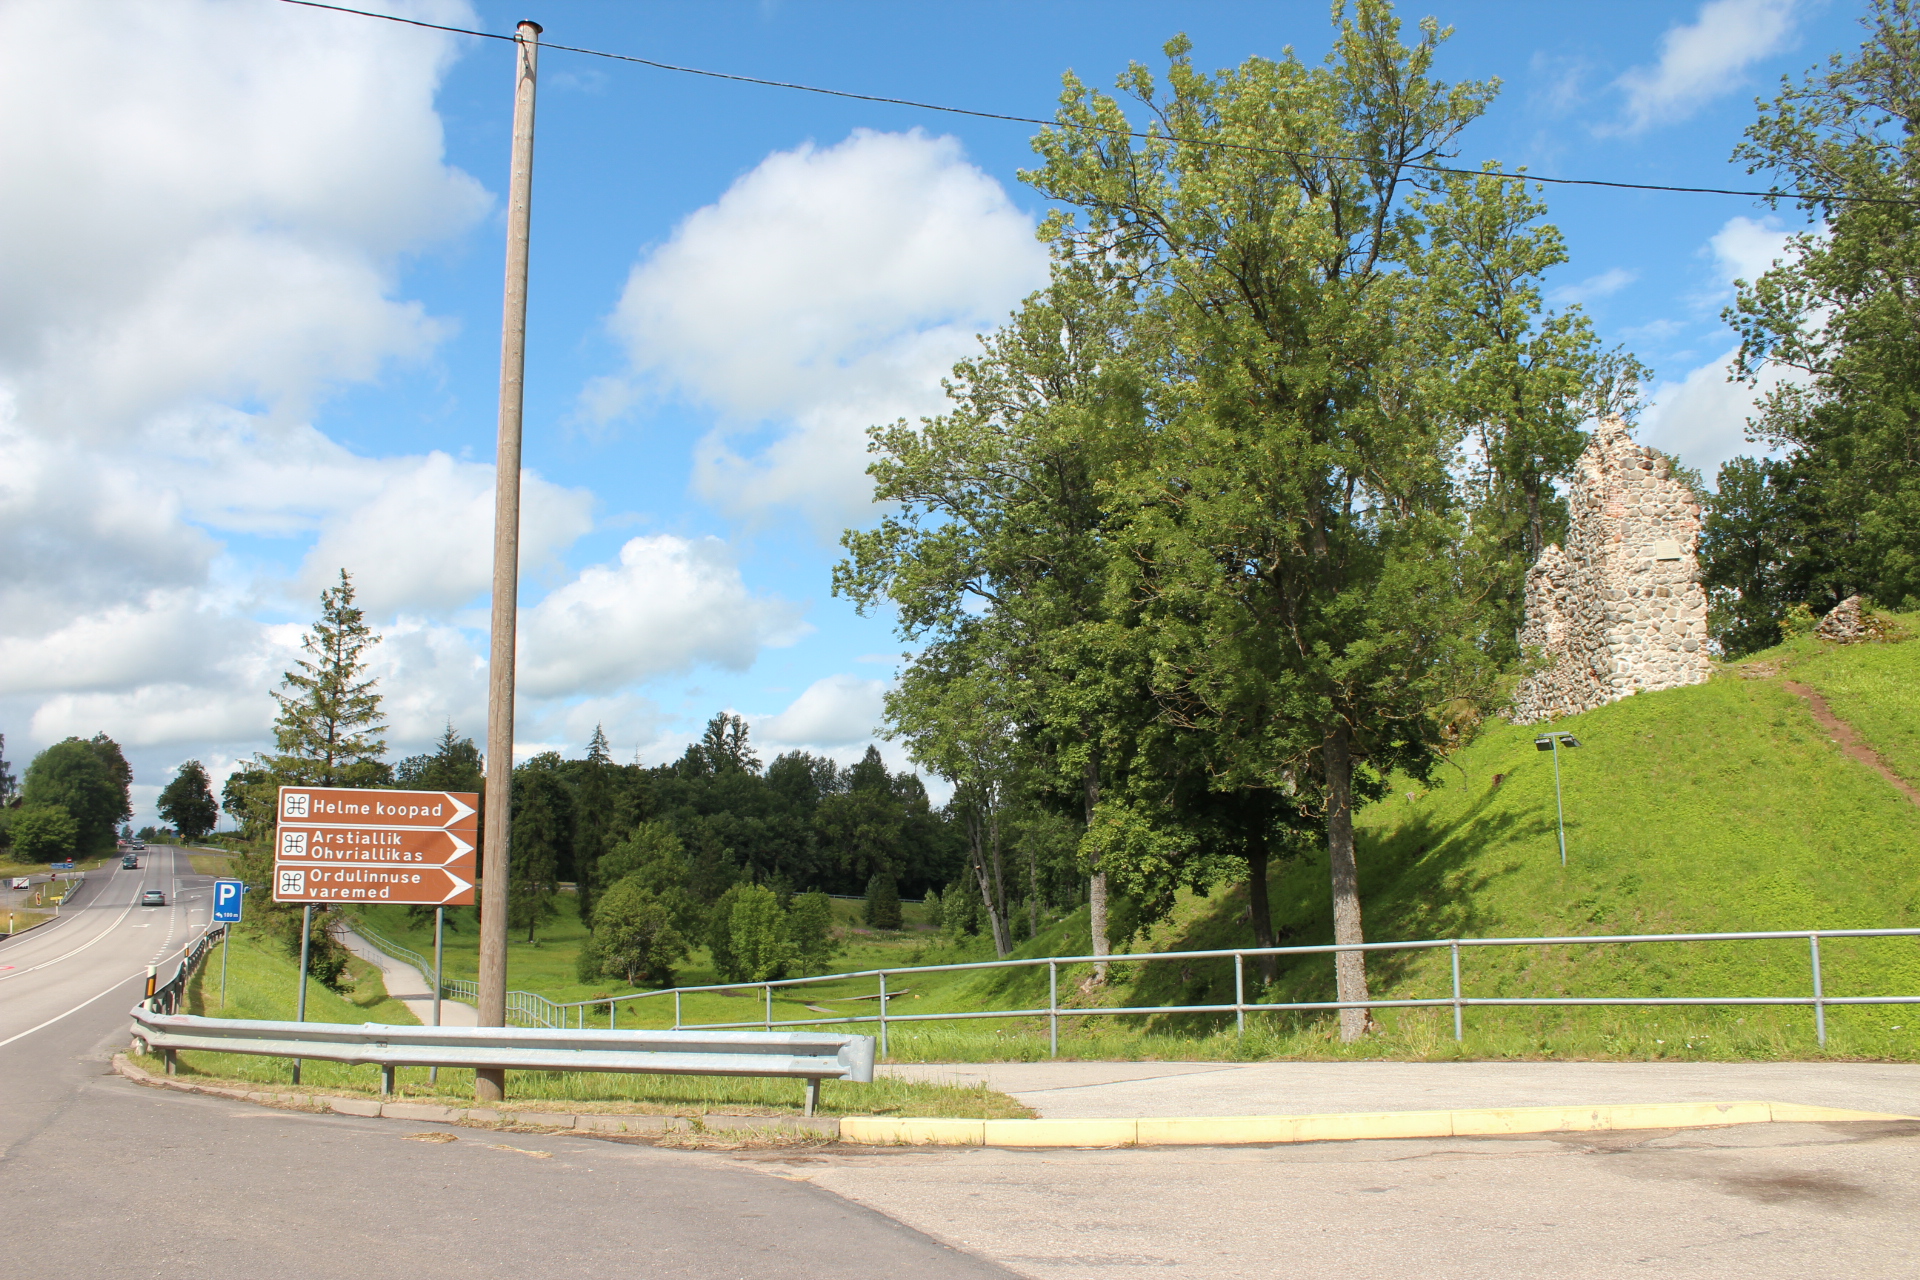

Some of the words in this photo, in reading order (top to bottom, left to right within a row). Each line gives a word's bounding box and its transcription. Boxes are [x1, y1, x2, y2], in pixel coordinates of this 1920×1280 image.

[313, 799, 370, 814] Helme
[376, 801, 443, 819] koopad
[311, 831, 402, 845] Arstiallik
[311, 846, 423, 861] Ohvriallikas
[310, 869, 421, 884] Ordulinnuse
[219, 884, 236, 906] P
[309, 886, 390, 899] varemed
